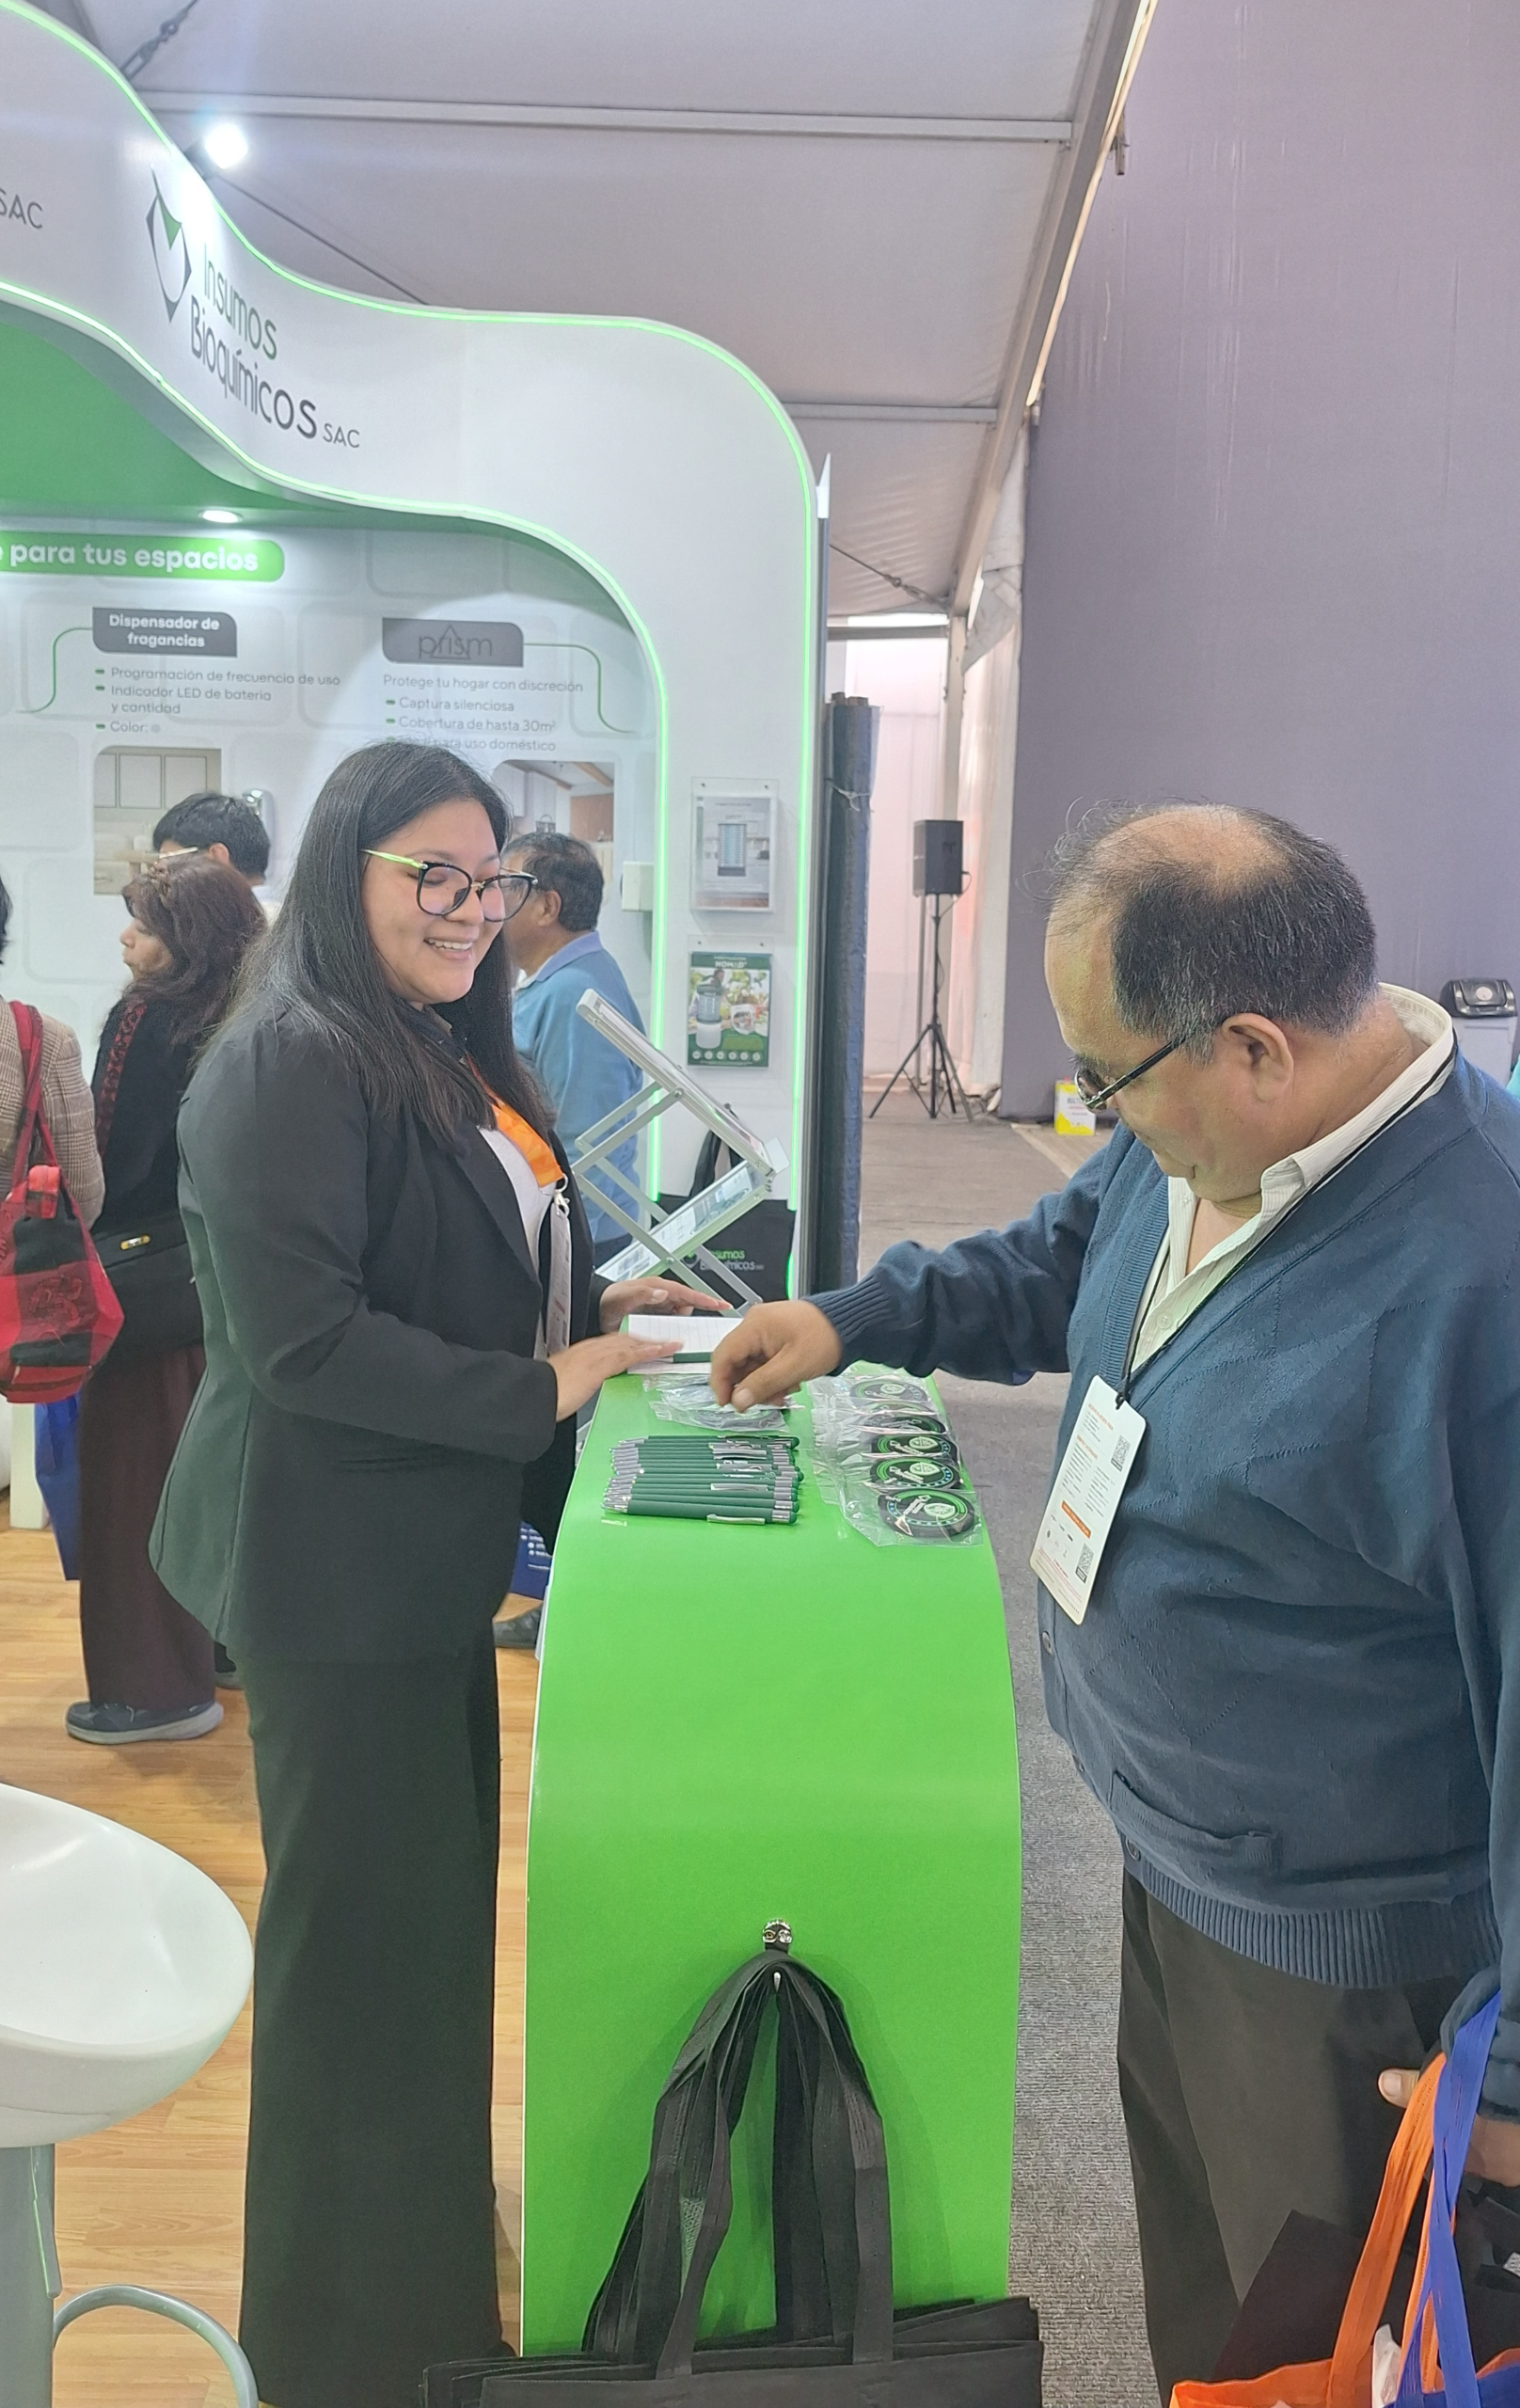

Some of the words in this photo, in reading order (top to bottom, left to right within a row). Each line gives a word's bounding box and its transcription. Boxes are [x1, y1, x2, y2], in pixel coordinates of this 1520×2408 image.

[204, 242, 277, 360] Insumos
[191, 294, 318, 439] Bioquímicos
[322, 422, 360, 449] SAC
[9, 543, 75, 567] para
[83, 544, 128, 566] tus
[135, 546, 260, 573] espacios
[109, 613, 198, 633] Dispensador
[201, 617, 220, 631] de
[127, 632, 205, 649] fragancias
[419, 636, 493, 658] prism
[111, 667, 203, 683] Programación
[207, 671, 223, 682] de
[227, 671, 294, 685] frecuencia
[298, 673, 314, 685] de
[318, 677, 340, 686] uso
[383, 674, 434, 690] Protege
[437, 676, 450, 689] tu
[453, 676, 488, 693] hogar
[492, 680, 515, 689] con
[518, 679, 583, 692] discreción
[111, 686, 173, 698] Indicador
[178, 688, 201, 699] LED
[205, 689, 221, 700] de
[111, 704, 119, 715] y
[121, 703, 181, 715] cantidad
[399, 697, 451, 713] Captura
[453, 699, 515, 712] silenciosa
[110, 721, 149, 734] Color:
[399, 716, 464, 730] Cobertura
[467, 719, 483, 730] de
[486, 720, 519, 731] hasta
[465, 740, 486, 750] uso
[489, 738, 556, 752] doméstico
